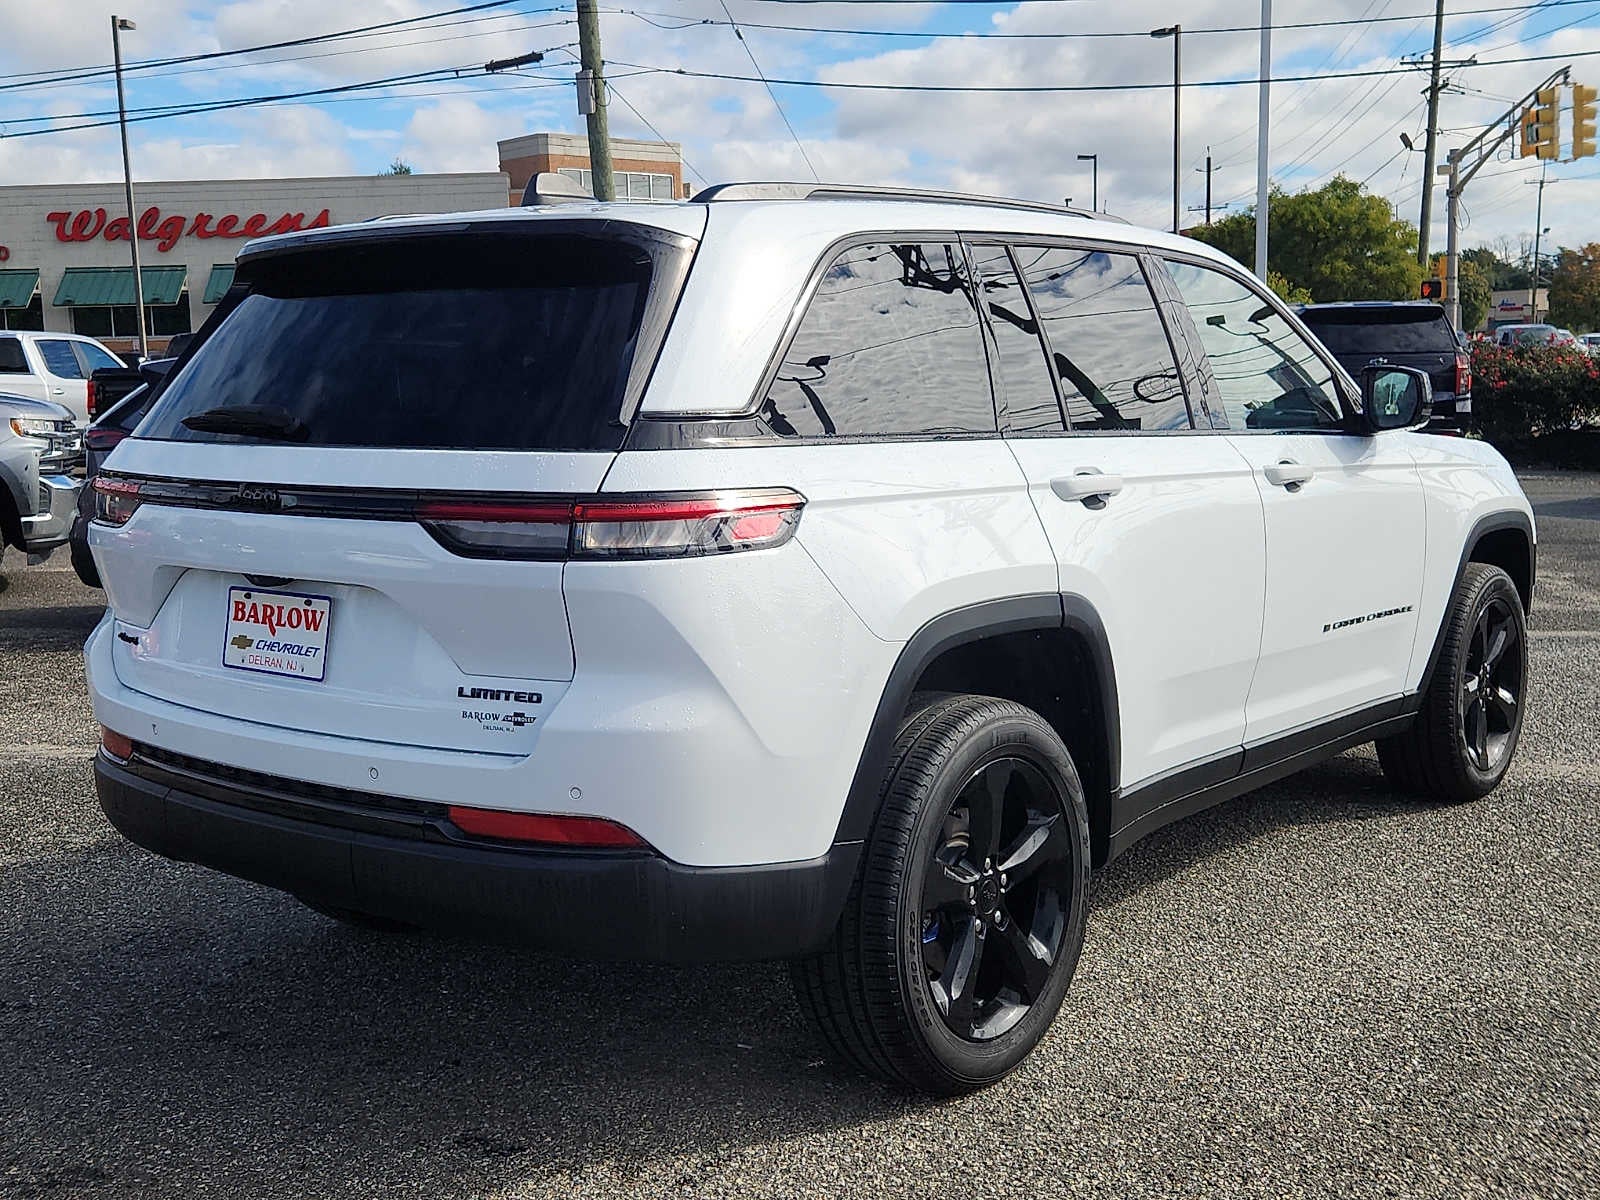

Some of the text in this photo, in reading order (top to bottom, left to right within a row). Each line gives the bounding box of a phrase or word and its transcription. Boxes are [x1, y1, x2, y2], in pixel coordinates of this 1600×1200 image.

[46, 206, 330, 252] Walgreens
[232, 600, 325, 637] BARLOW
[255, 640, 321, 658] CHEVROLET
[248, 654, 298, 671] DELRAN, NJ
[457, 686, 543, 704] LIMITED
[461, 710, 501, 723] BARLOW
